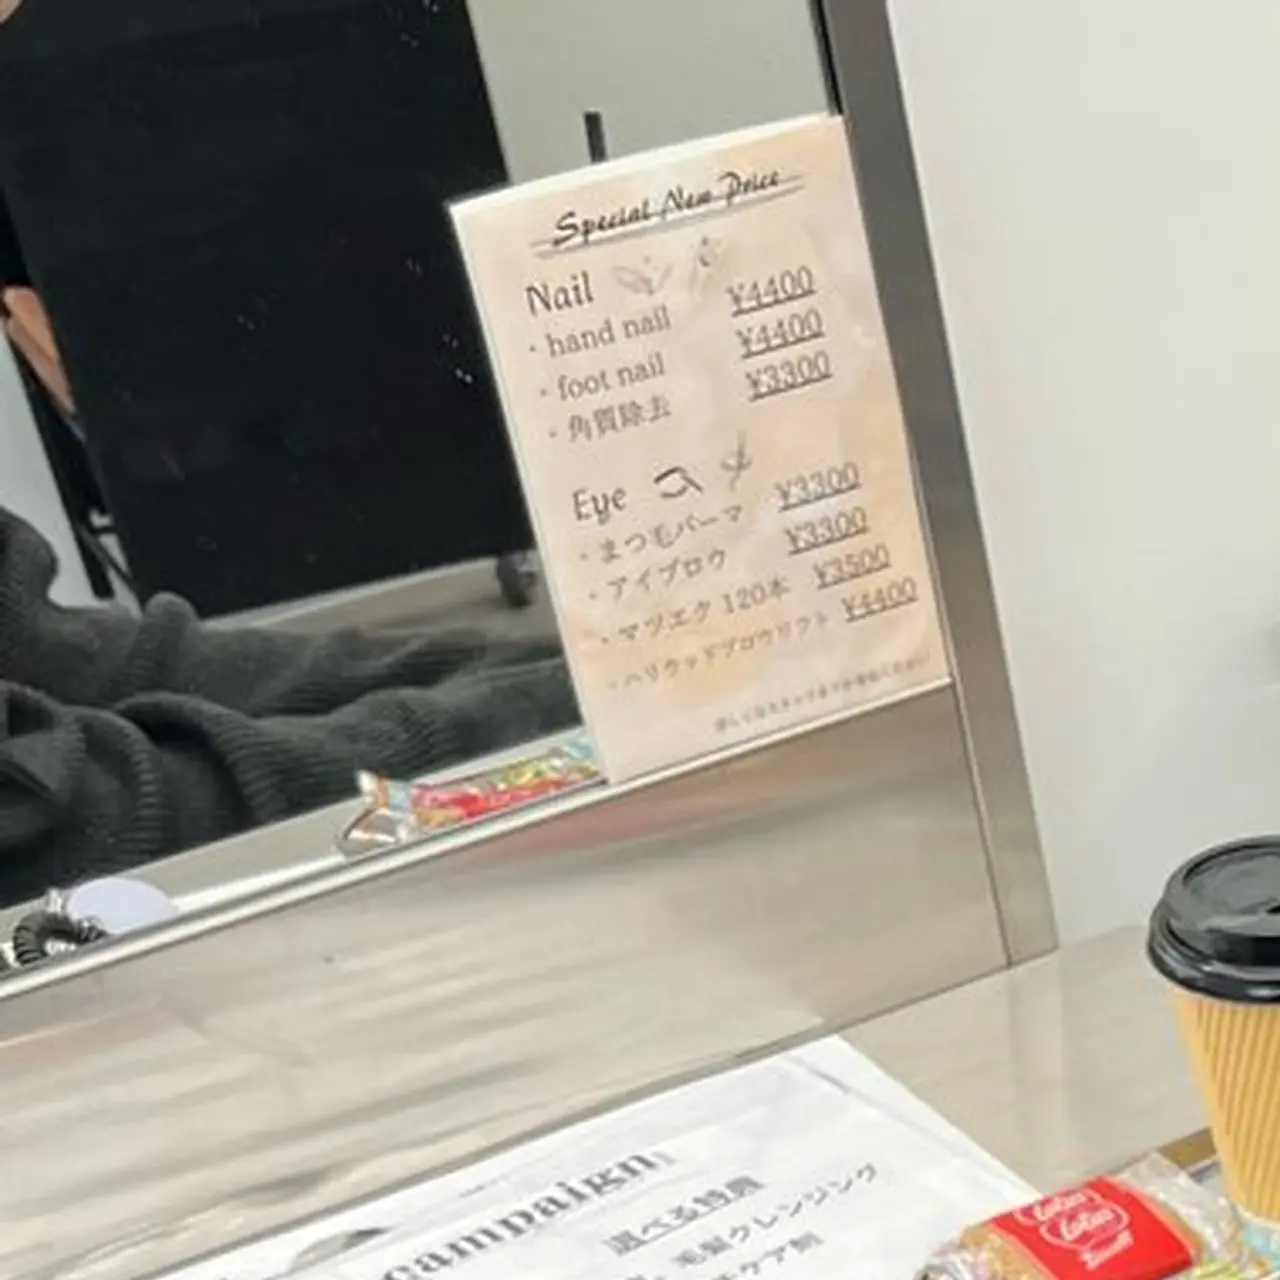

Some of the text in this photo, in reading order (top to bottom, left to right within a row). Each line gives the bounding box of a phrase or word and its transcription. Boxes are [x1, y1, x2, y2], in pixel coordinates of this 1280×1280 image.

[552, 200, 652, 246] Special
[718, 170, 782, 205] Price
[525, 269, 595, 317] Nail
[548, 264, 816, 357] hand nail ¥4400
[557, 307, 825, 401] foot nail ¥4400
[744, 351, 833, 400] ¥3300
[572, 487, 627, 524] Eye
[606, 548, 727, 600] アイブロウ
[603, 1174, 765, 1256] 選べる特典
